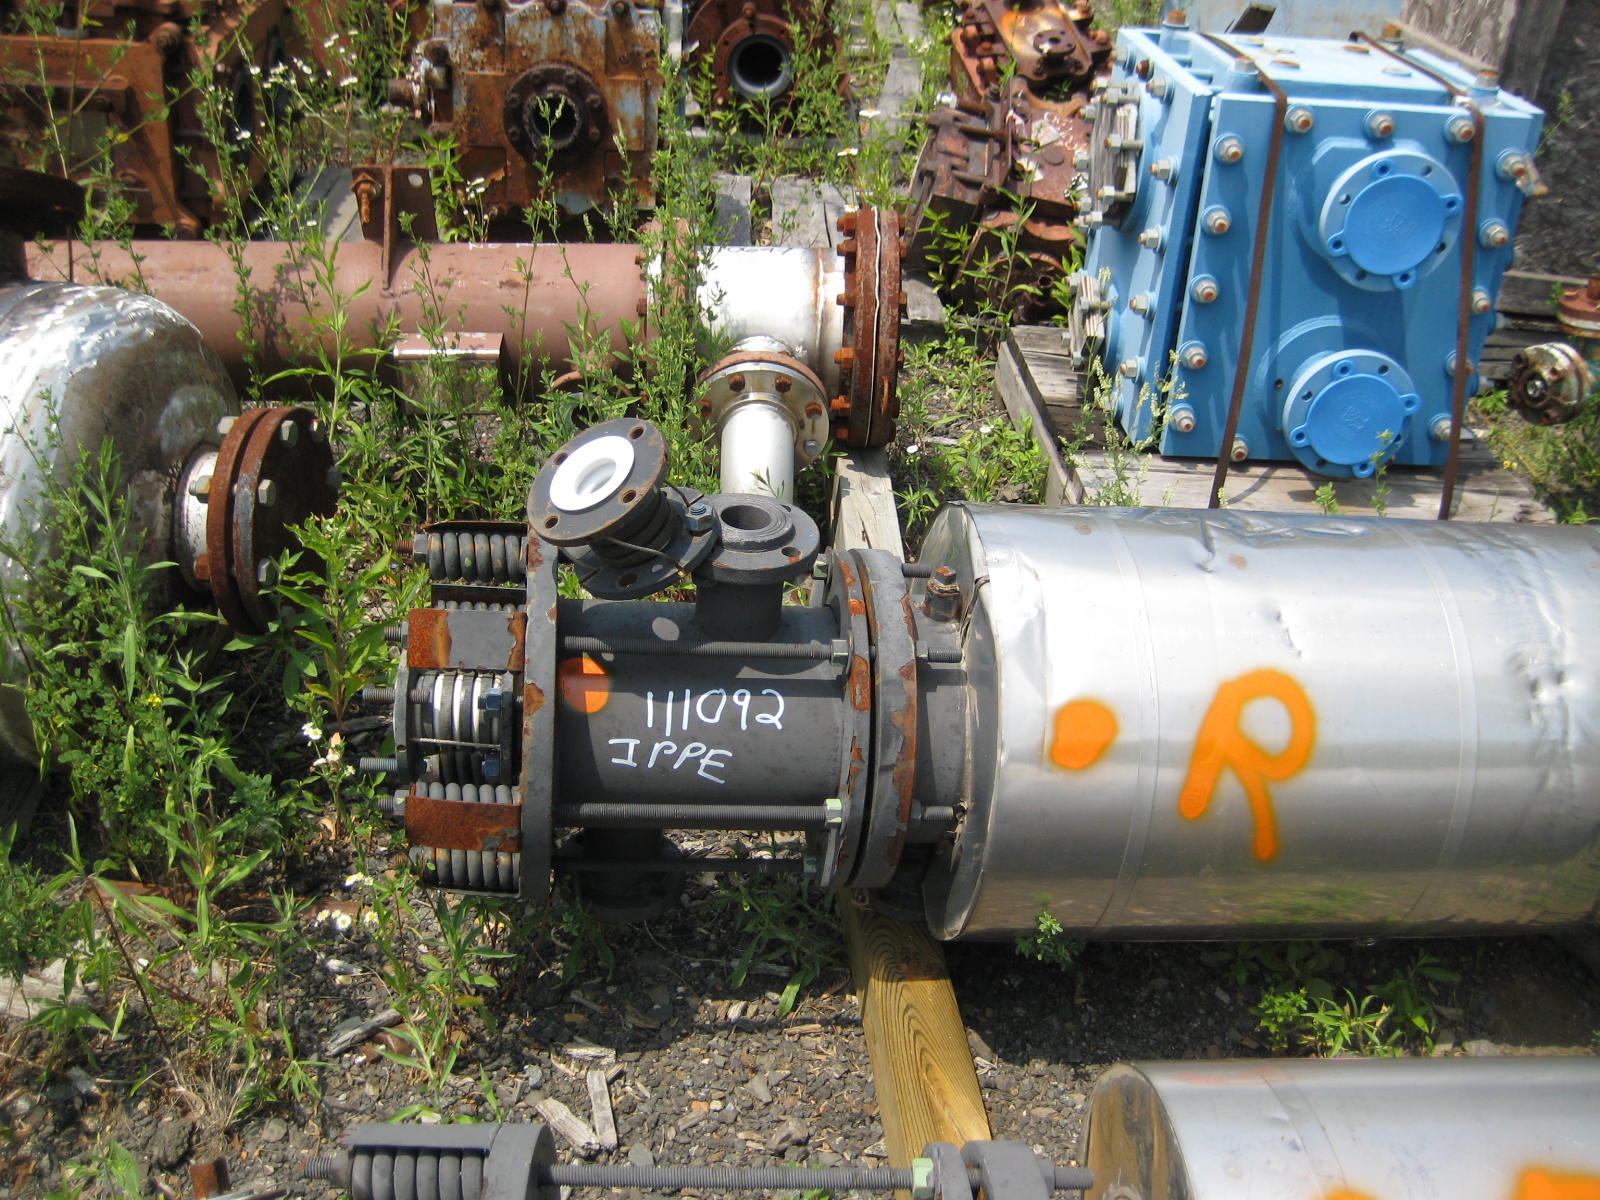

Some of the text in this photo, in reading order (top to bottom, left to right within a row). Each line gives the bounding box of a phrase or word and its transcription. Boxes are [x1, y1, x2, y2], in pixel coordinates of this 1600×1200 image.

[647, 688, 785, 737] 111092
[608, 738, 733, 784] IPPE
[1178, 667, 1316, 861] R
